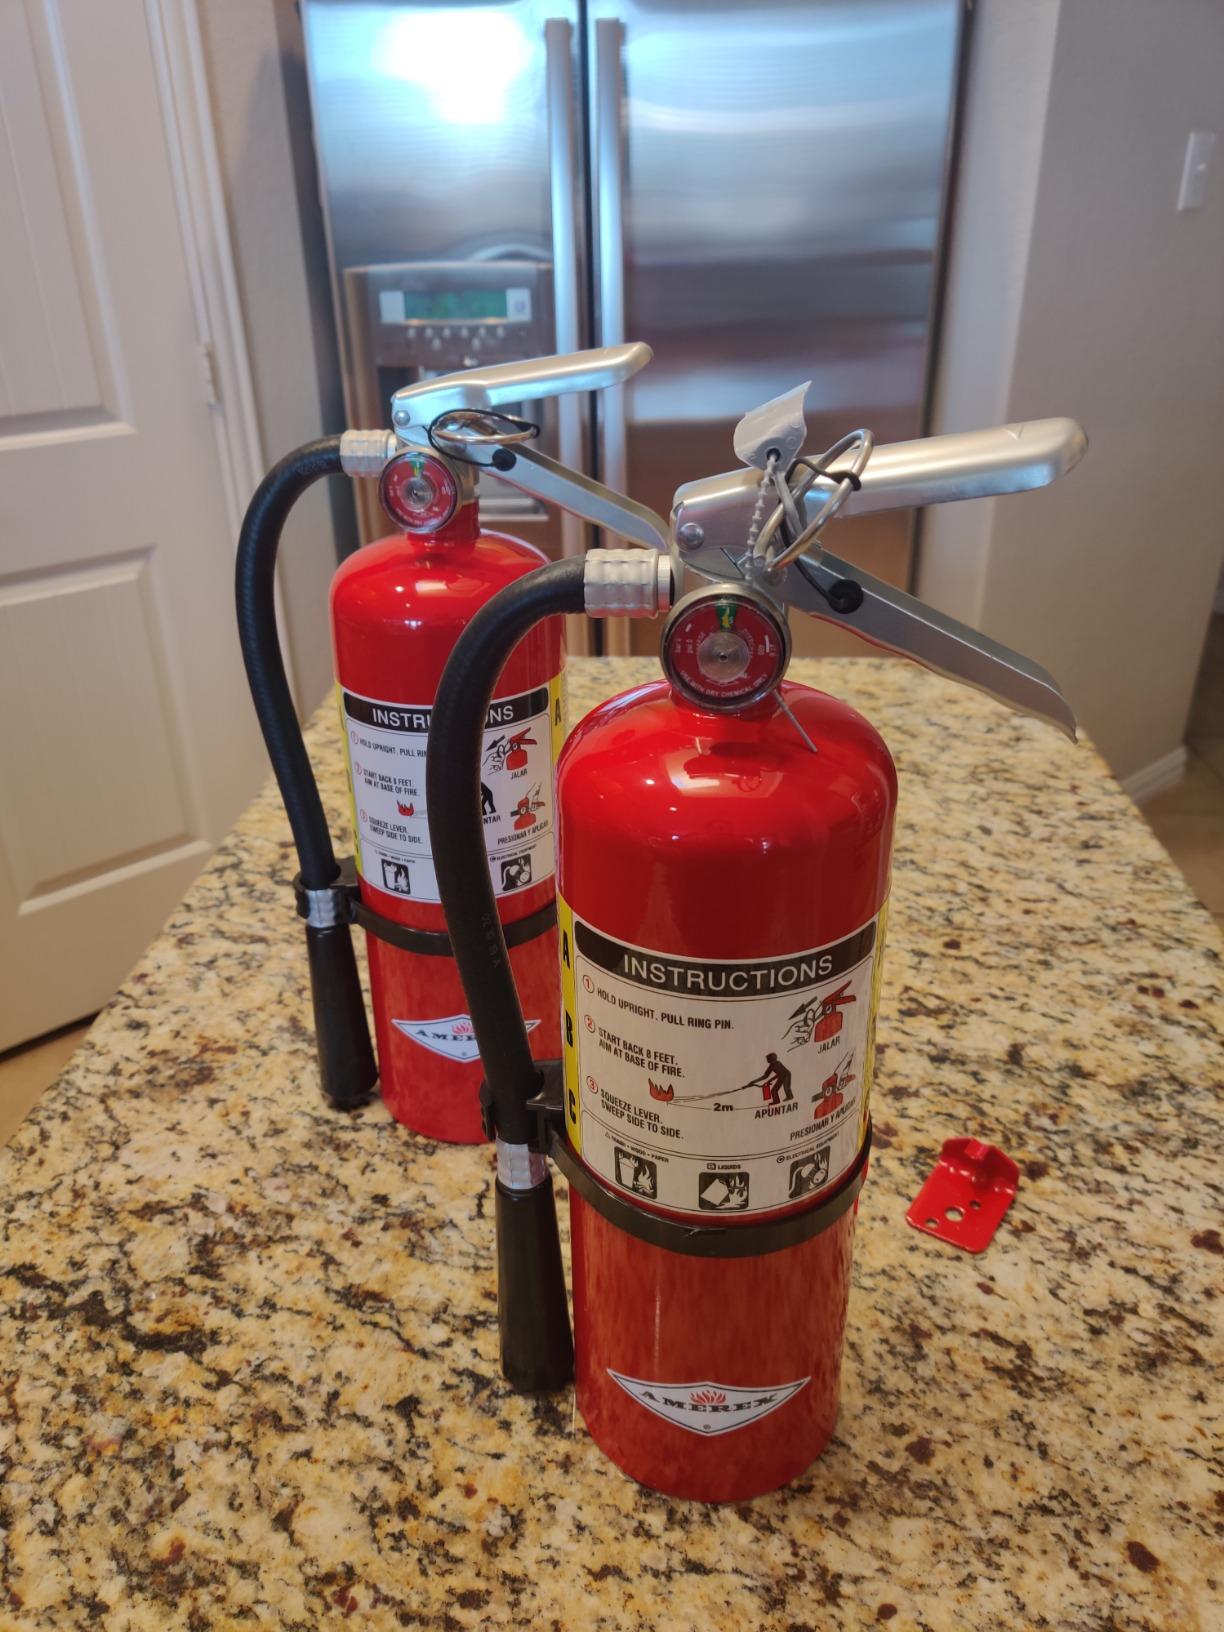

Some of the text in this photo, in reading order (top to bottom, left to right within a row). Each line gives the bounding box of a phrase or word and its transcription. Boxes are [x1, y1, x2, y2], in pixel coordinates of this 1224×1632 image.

[372, 705, 514, 729] INSTRNS
[400, 748, 415, 757] PULL
[379, 774, 392, 784] BACK
[510, 769, 527, 780] JALAR
[395, 786, 402, 794] OF
[483, 815, 501, 825] NTAR
[386, 831, 397, 840] SIDE
[399, 834, 406, 842] TO
[563, 930, 571, 970] A
[623, 953, 833, 991] INSTRUCTIONS
[597, 987, 616, 1005] HOLD
[661, 1012, 684, 1026] PULL
[687, 1017, 711, 1029] RING
[714, 1019, 734, 1030] PIN.
[565, 1009, 574, 1048] B
[599, 1027, 620, 1047] START
[623, 1039, 644, 1057] BACK
[646, 1049, 651, 1059] 8
[654, 1051, 679, 1066] FEET.
[817, 1036, 841, 1055] JALAR
[599, 1038, 685, 1079] AIM AT BASE OF FIRE.
[569, 1087, 577, 1125] C
[600, 1088, 632, 1114] SQUEEZE
[634, 1106, 663, 1125] LEVER.
[713, 1102, 734, 1112] 2m
[754, 1102, 799, 1120] APUNTAR
[601, 1099, 684, 1139] SWEEP SIDE TO SIDE.
[790, 1117, 829, 1141] PRESIONAR
[830, 1113, 835, 1123] Y
[640, 1390, 778, 1413] AMEREX
